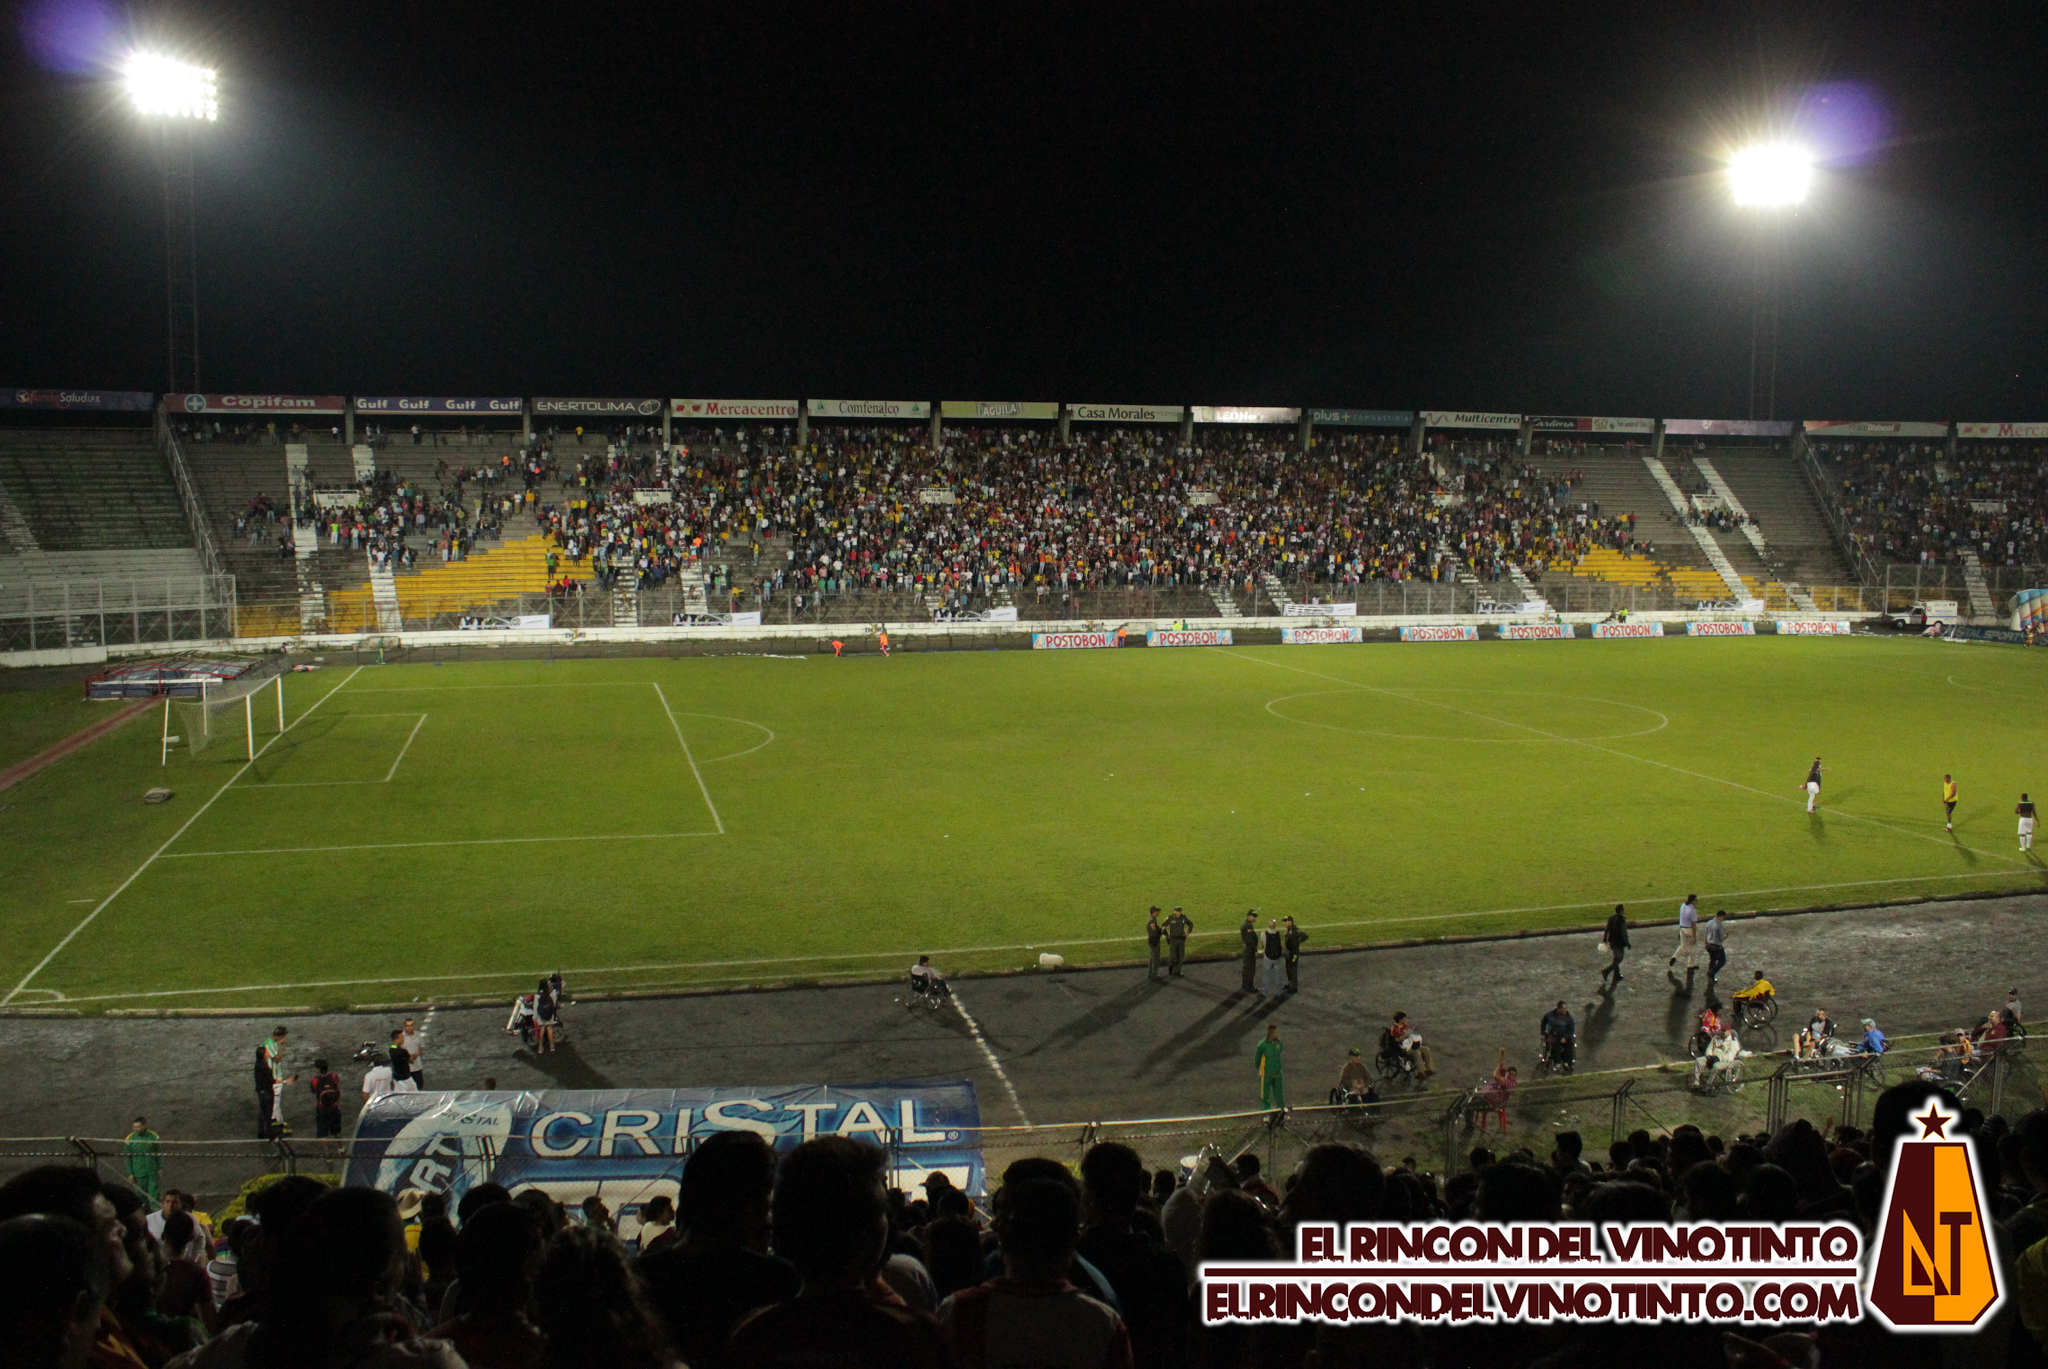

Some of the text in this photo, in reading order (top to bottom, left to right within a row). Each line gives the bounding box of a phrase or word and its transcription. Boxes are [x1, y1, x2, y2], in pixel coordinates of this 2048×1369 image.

[222, 396, 316, 408] Copifam
[357, 398, 520, 410] Gulf Gulf Gulf Gulf
[537, 401, 636, 411] ENERTOLIMA
[704, 402, 796, 415] Mercacentro
[839, 401, 900, 414] Comfenalco
[1077, 406, 1156, 420] Casa Morales
[1454, 413, 1520, 424] Multicentro
[1412, 627, 1464, 640] POSTOBON
[1510, 626, 1562, 639] POSTOBON
[1602, 624, 1651, 637] POSTOBON
[1696, 623, 1744, 635] POSTOBON
[1787, 622, 1838, 634] POSTOBON
[1045, 634, 1106, 648] POSTOBON
[1159, 631, 1218, 645] POSTOBON
[1294, 629, 1349, 642] POSTOBON
[531, 1099, 946, 1158] CRISTAL
